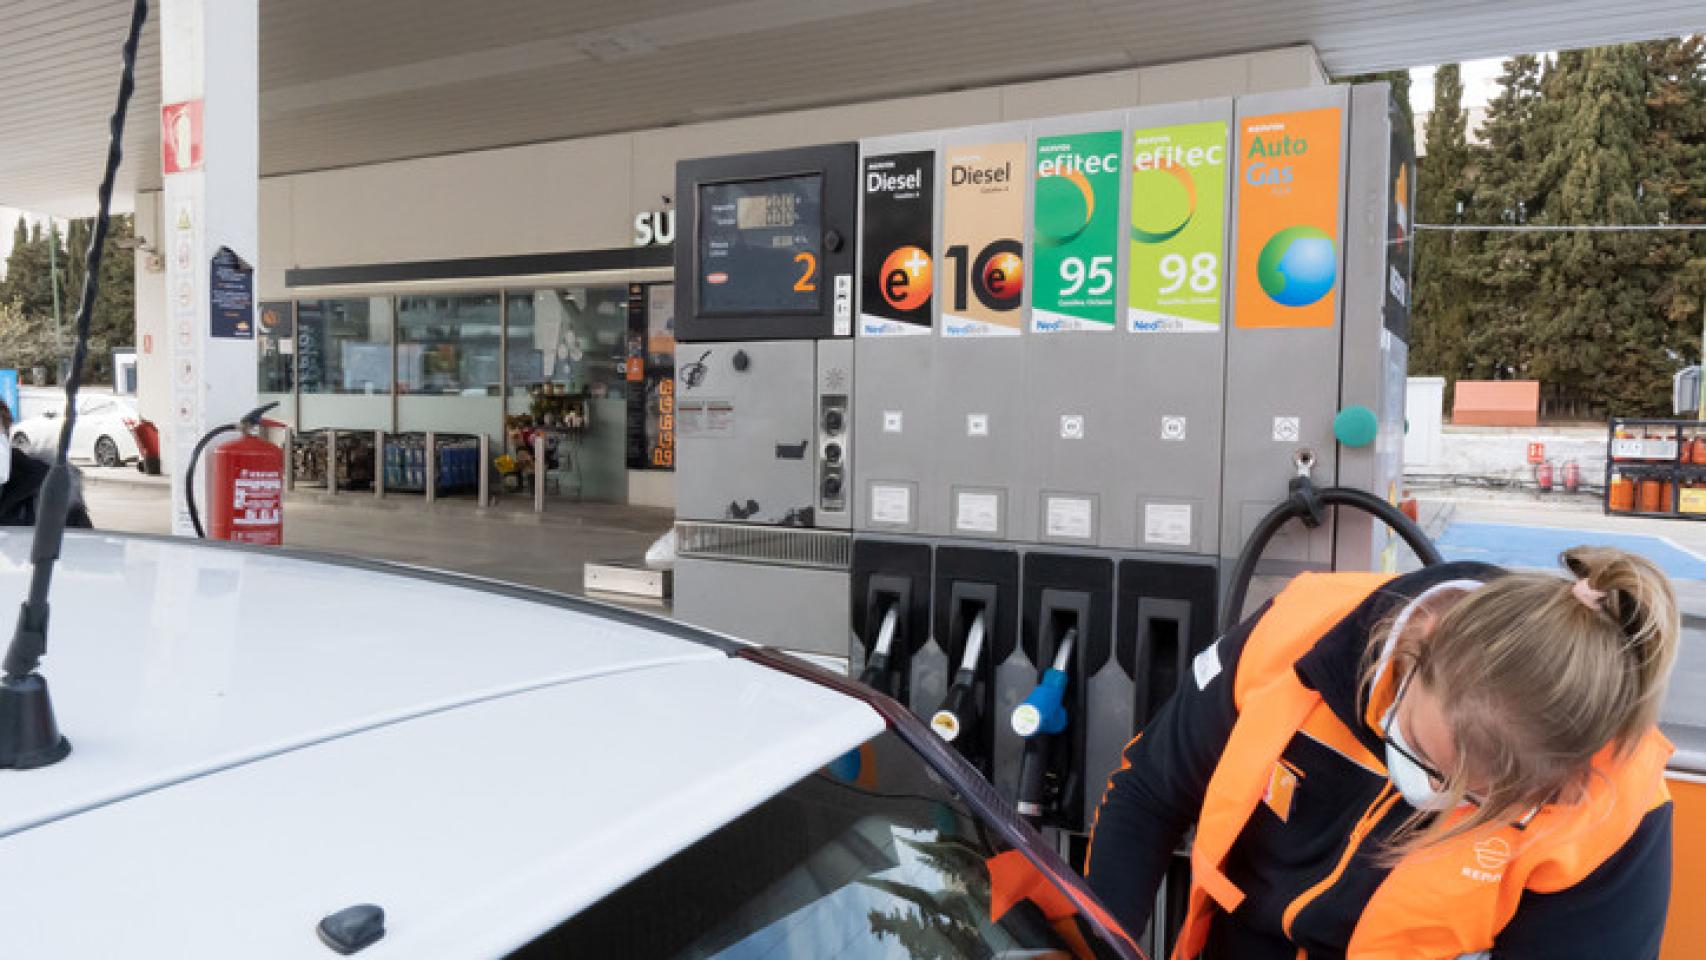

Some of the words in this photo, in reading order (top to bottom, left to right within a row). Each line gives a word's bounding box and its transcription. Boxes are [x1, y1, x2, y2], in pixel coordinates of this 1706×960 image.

[1135, 144, 1222, 172] efitec
[1248, 135, 1308, 159] Auto
[951, 162, 1011, 186] Diesel
[1038, 153, 1118, 177] efitec
[1246, 162, 1294, 186] Gas
[866, 168, 922, 193] Diesel
[793, 252, 817, 292] 2
[1059, 256, 1113, 296] 95
[1158, 252, 1217, 294] 98
